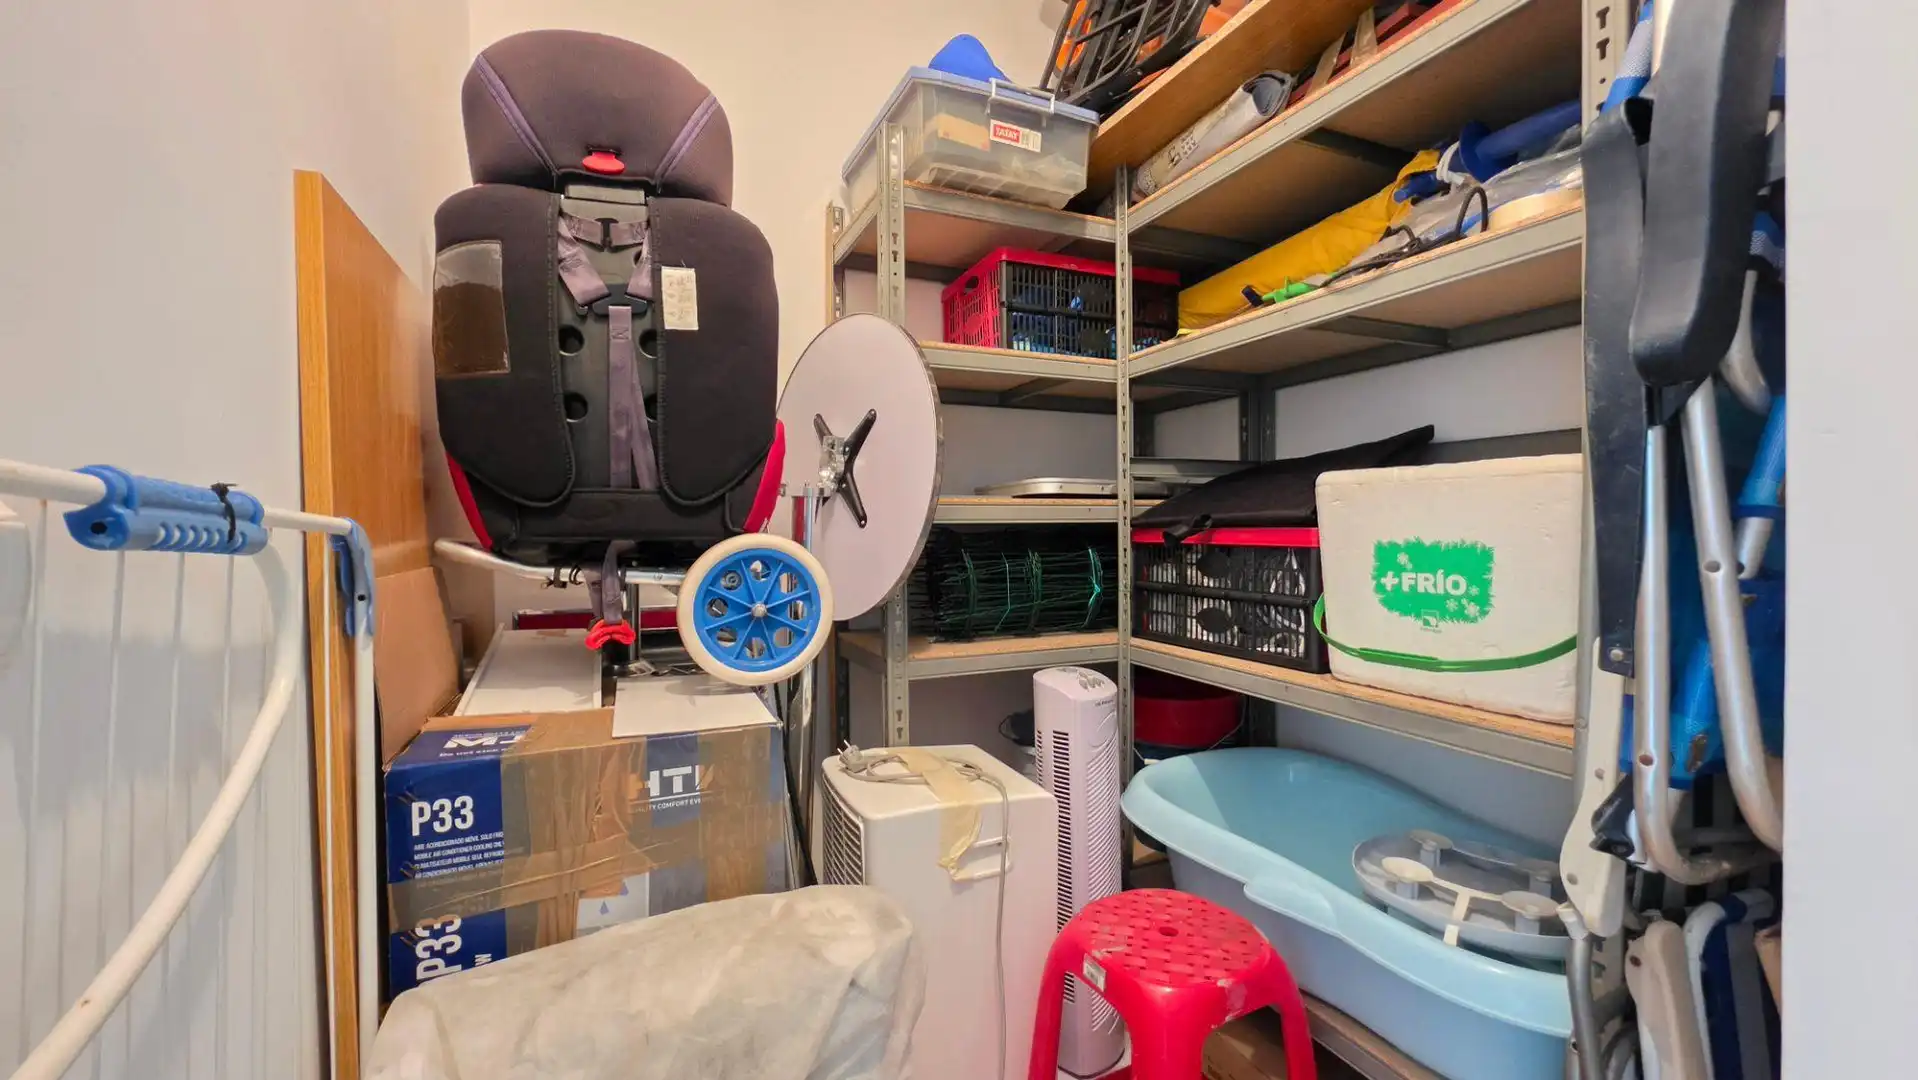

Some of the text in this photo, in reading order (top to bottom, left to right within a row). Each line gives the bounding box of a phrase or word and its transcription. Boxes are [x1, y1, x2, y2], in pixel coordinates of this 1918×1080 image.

[994, 126, 1019, 141] TATAY
[657, 799, 688, 810] COMFORT
[411, 795, 474, 836] P33
[442, 845, 473, 857] CONDITIONER
[473, 842, 493, 851] COOLING
[415, 914, 462, 981] P33
